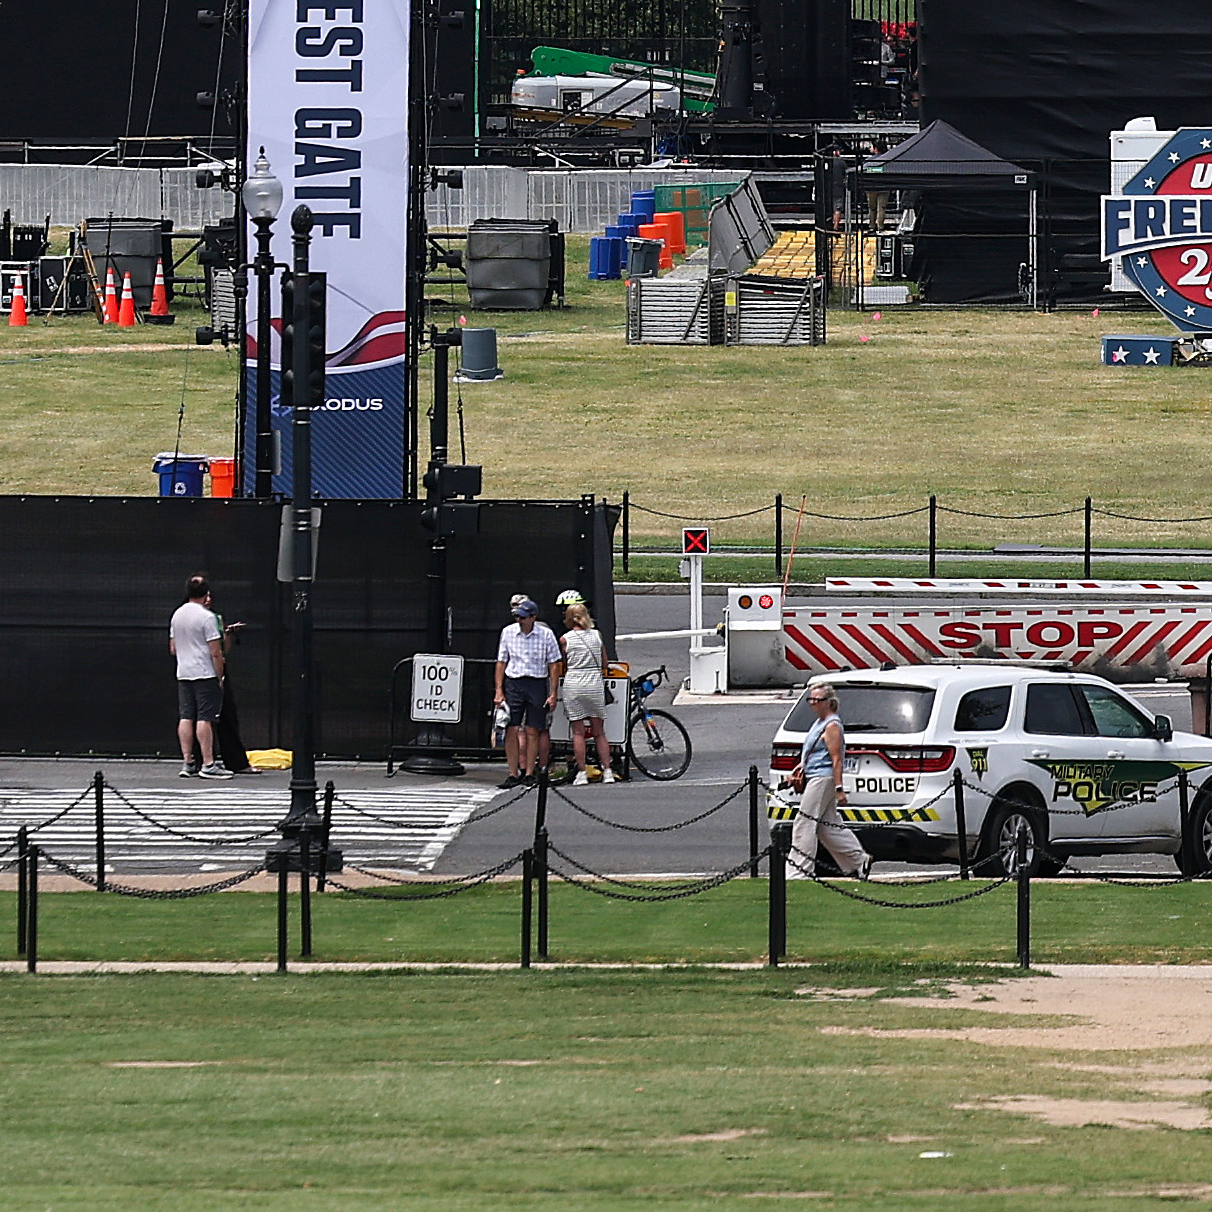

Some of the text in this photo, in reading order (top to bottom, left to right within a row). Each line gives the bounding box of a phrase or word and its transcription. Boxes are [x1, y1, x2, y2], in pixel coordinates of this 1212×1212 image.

[294, 107, 363, 240] GATE
[310, 398, 384, 411] ODUS
[938, 620, 1124, 649] STOP
[430, 685, 443, 696] ID
[416, 698, 456, 711] CHECK
[971, 758, 986, 771] 911
[1050, 764, 1115, 780] MILITARY
[855, 777, 915, 793] POLICE
[1052, 780, 1159, 803] POLICE
